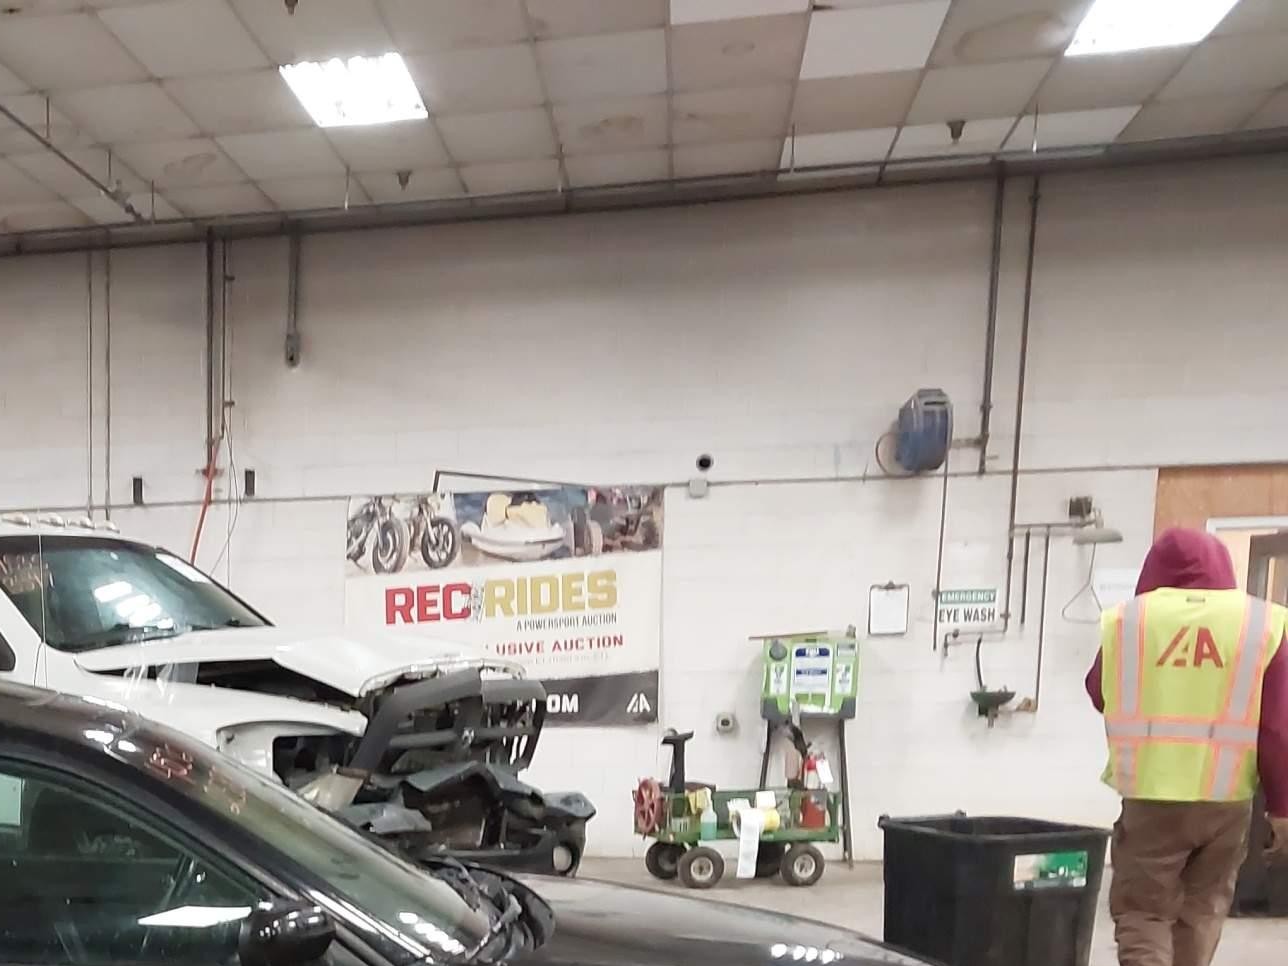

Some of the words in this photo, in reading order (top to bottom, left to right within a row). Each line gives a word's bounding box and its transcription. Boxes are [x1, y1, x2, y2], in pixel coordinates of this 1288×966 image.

[385, 582, 473, 625] REC
[484, 569, 618, 619] RIDES
[941, 591, 996, 602] EMERGENCY
[516, 619, 522, 631] A
[524, 615, 580, 630] POWERSPORT
[582, 612, 618, 627] AUCTION
[938, 608, 960, 623] EYE
[963, 607, 996, 622] WASH
[485, 640, 546, 657] USIVE
[552, 634, 624, 654] AUCTION
